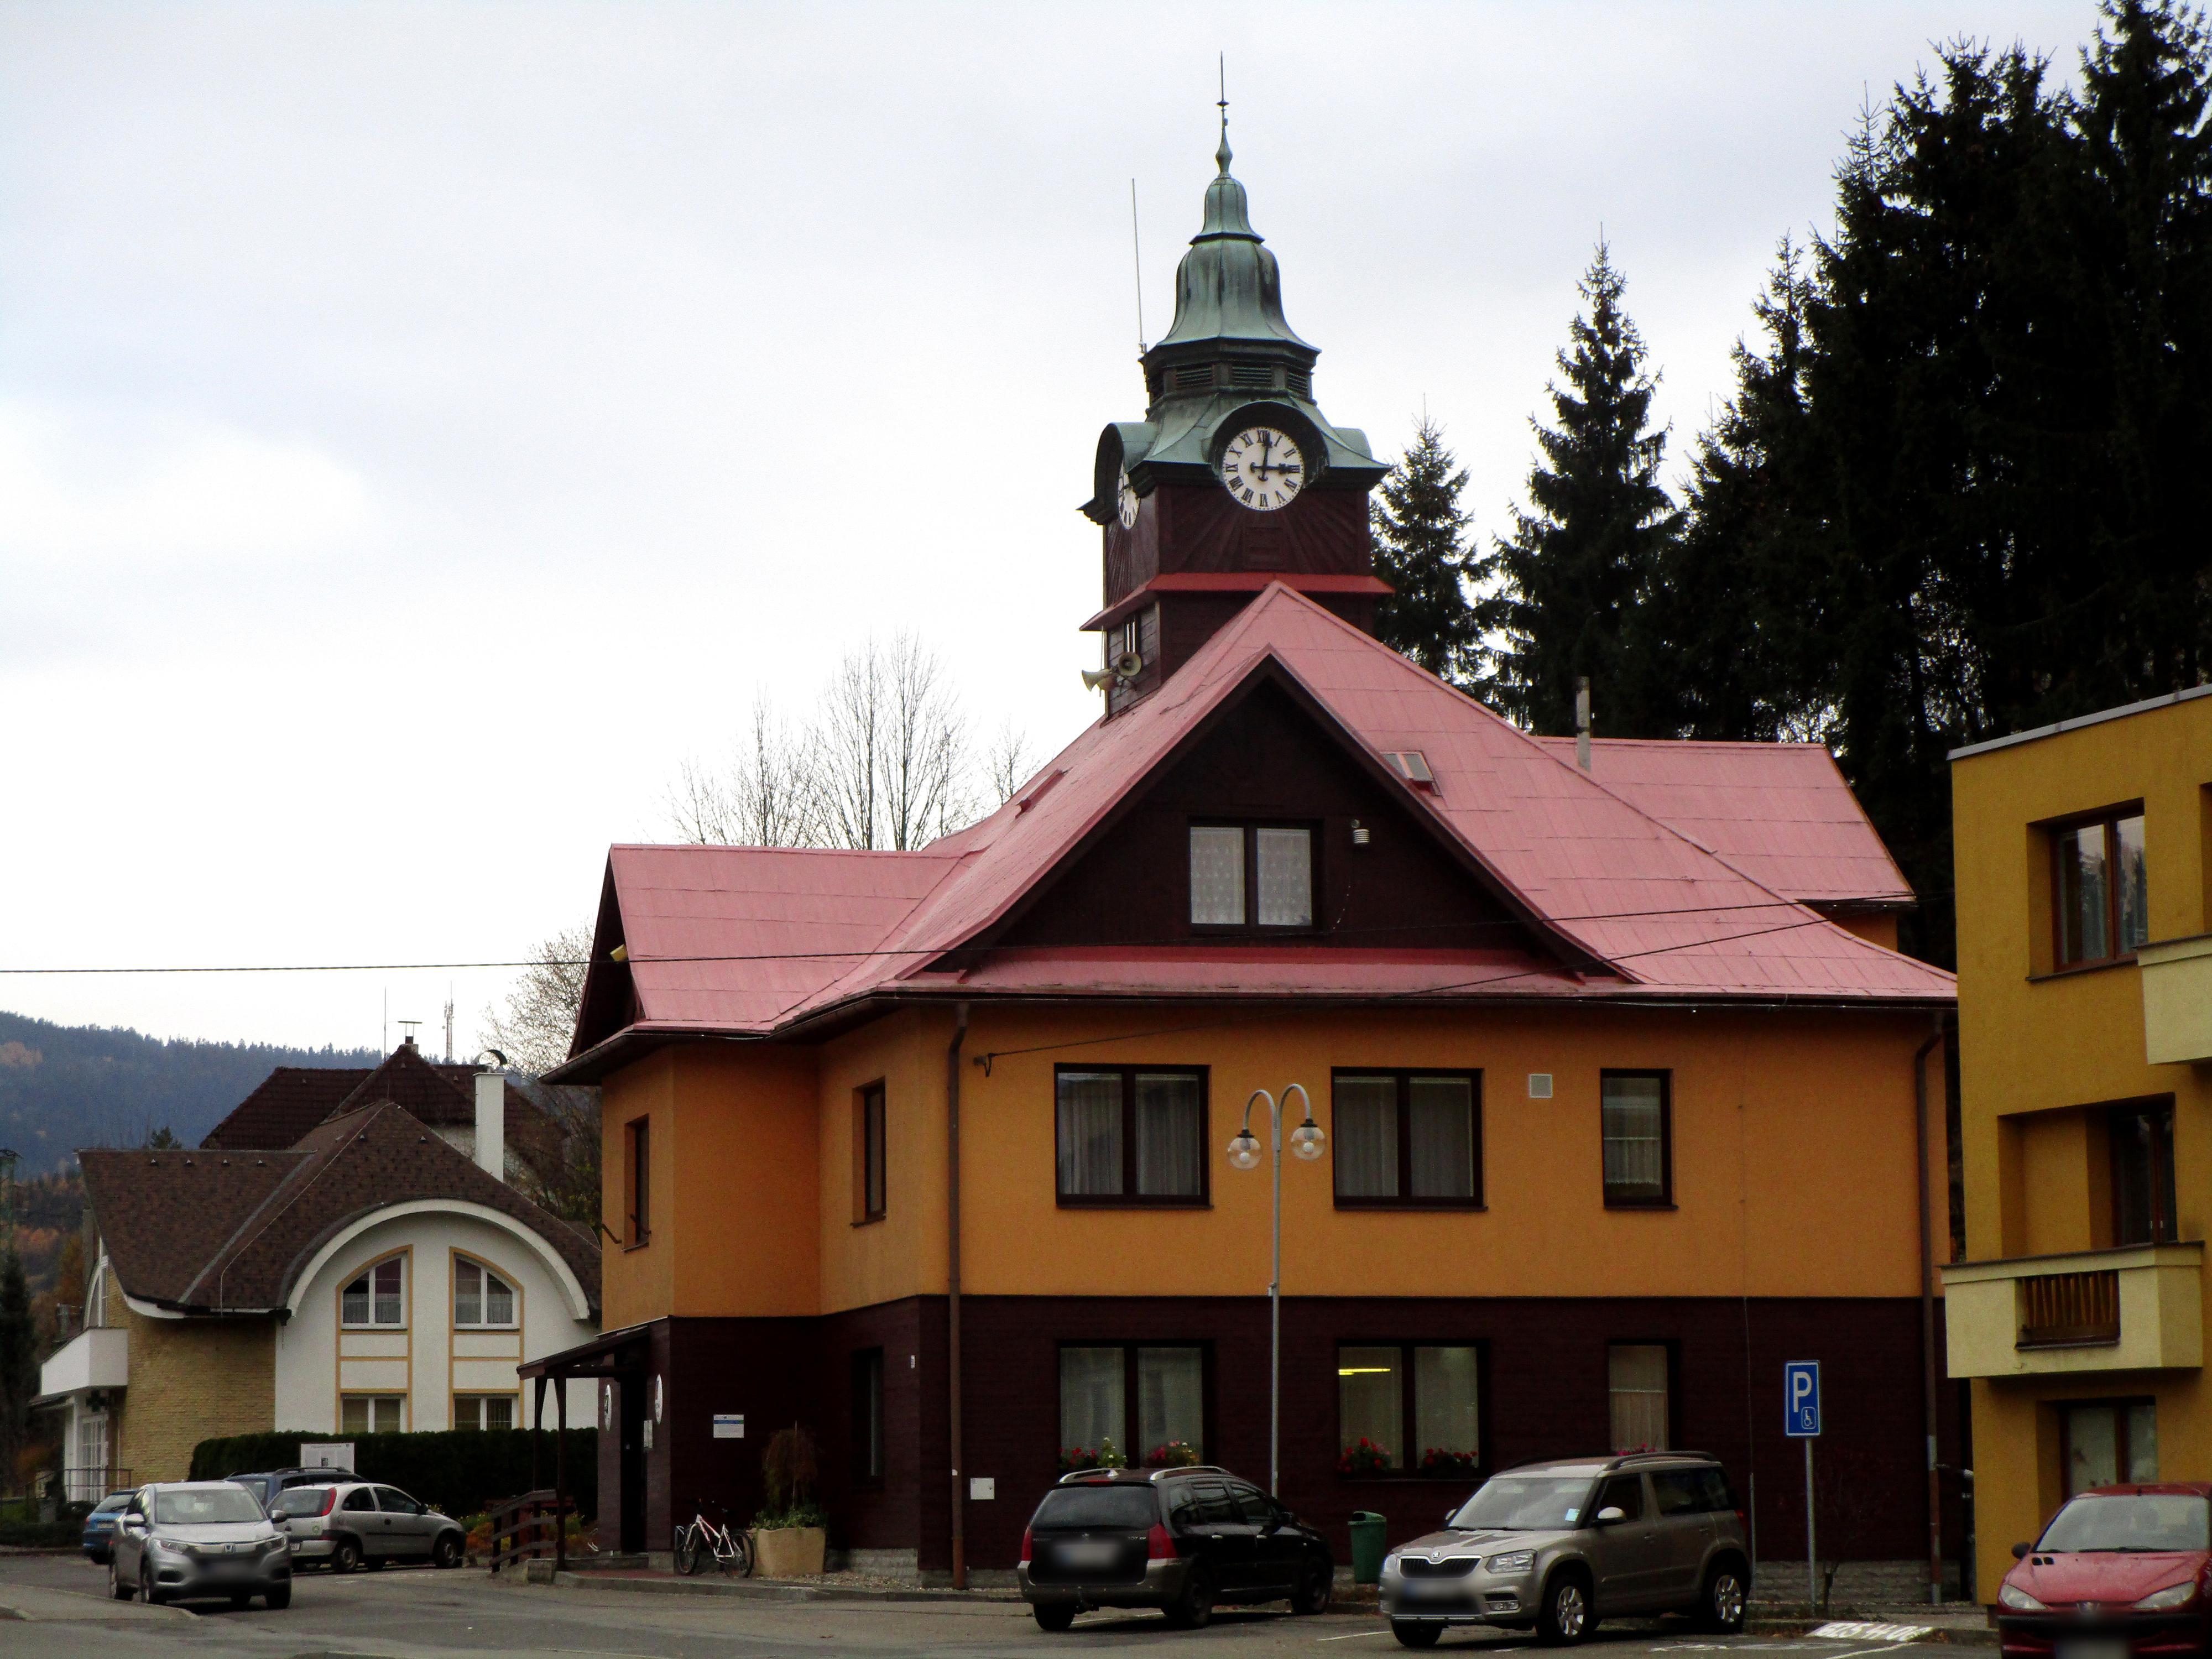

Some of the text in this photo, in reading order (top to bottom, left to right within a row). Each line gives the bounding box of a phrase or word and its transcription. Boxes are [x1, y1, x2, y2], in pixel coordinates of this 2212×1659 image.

[1240, 433, 1254, 448] XI
[1274, 435, 1282, 447] I
[1229, 446, 1243, 458] X
[1284, 448, 1296, 458] II
[1225, 463, 1238, 472] IX
[1275, 490, 1286, 503] V
[1793, 1371, 1812, 1413] P
